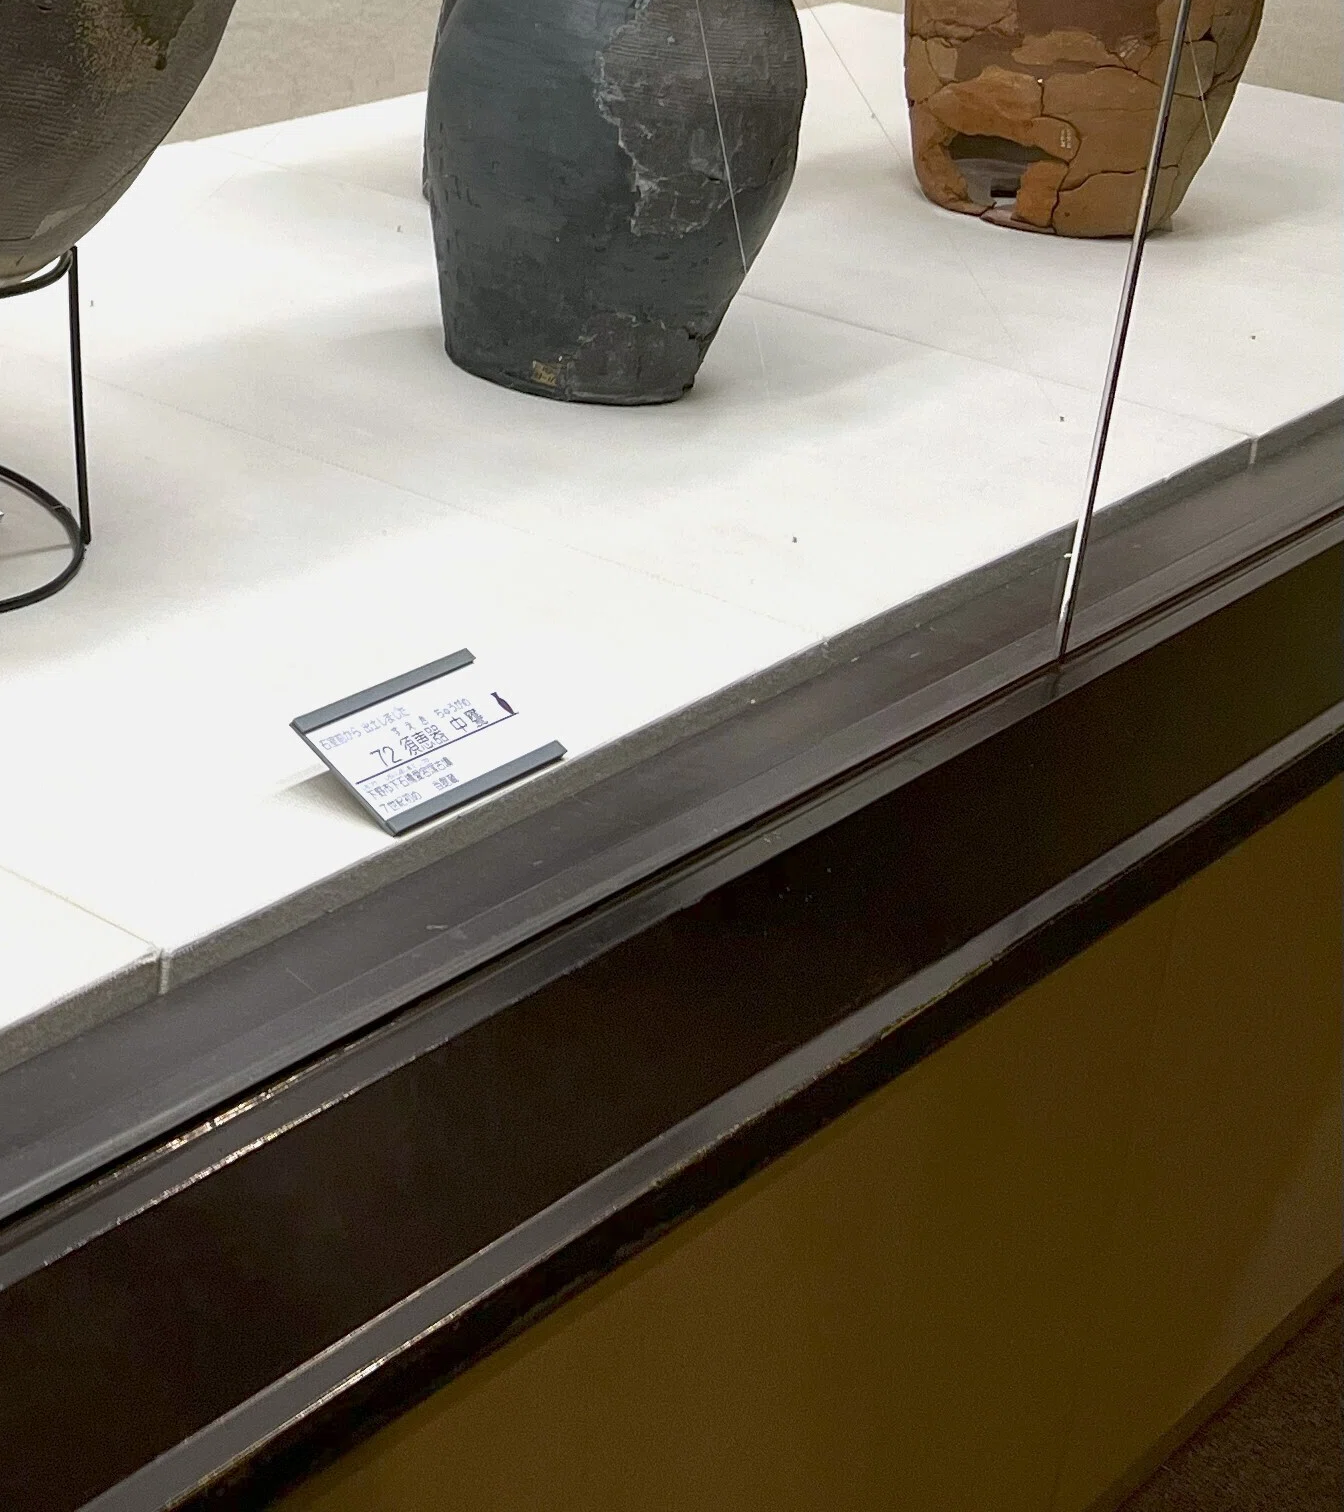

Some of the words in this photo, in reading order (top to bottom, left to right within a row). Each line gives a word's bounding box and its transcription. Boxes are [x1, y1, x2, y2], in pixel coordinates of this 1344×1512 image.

[370, 746, 403, 767] 72
[400, 725, 450, 756] 須恵器
